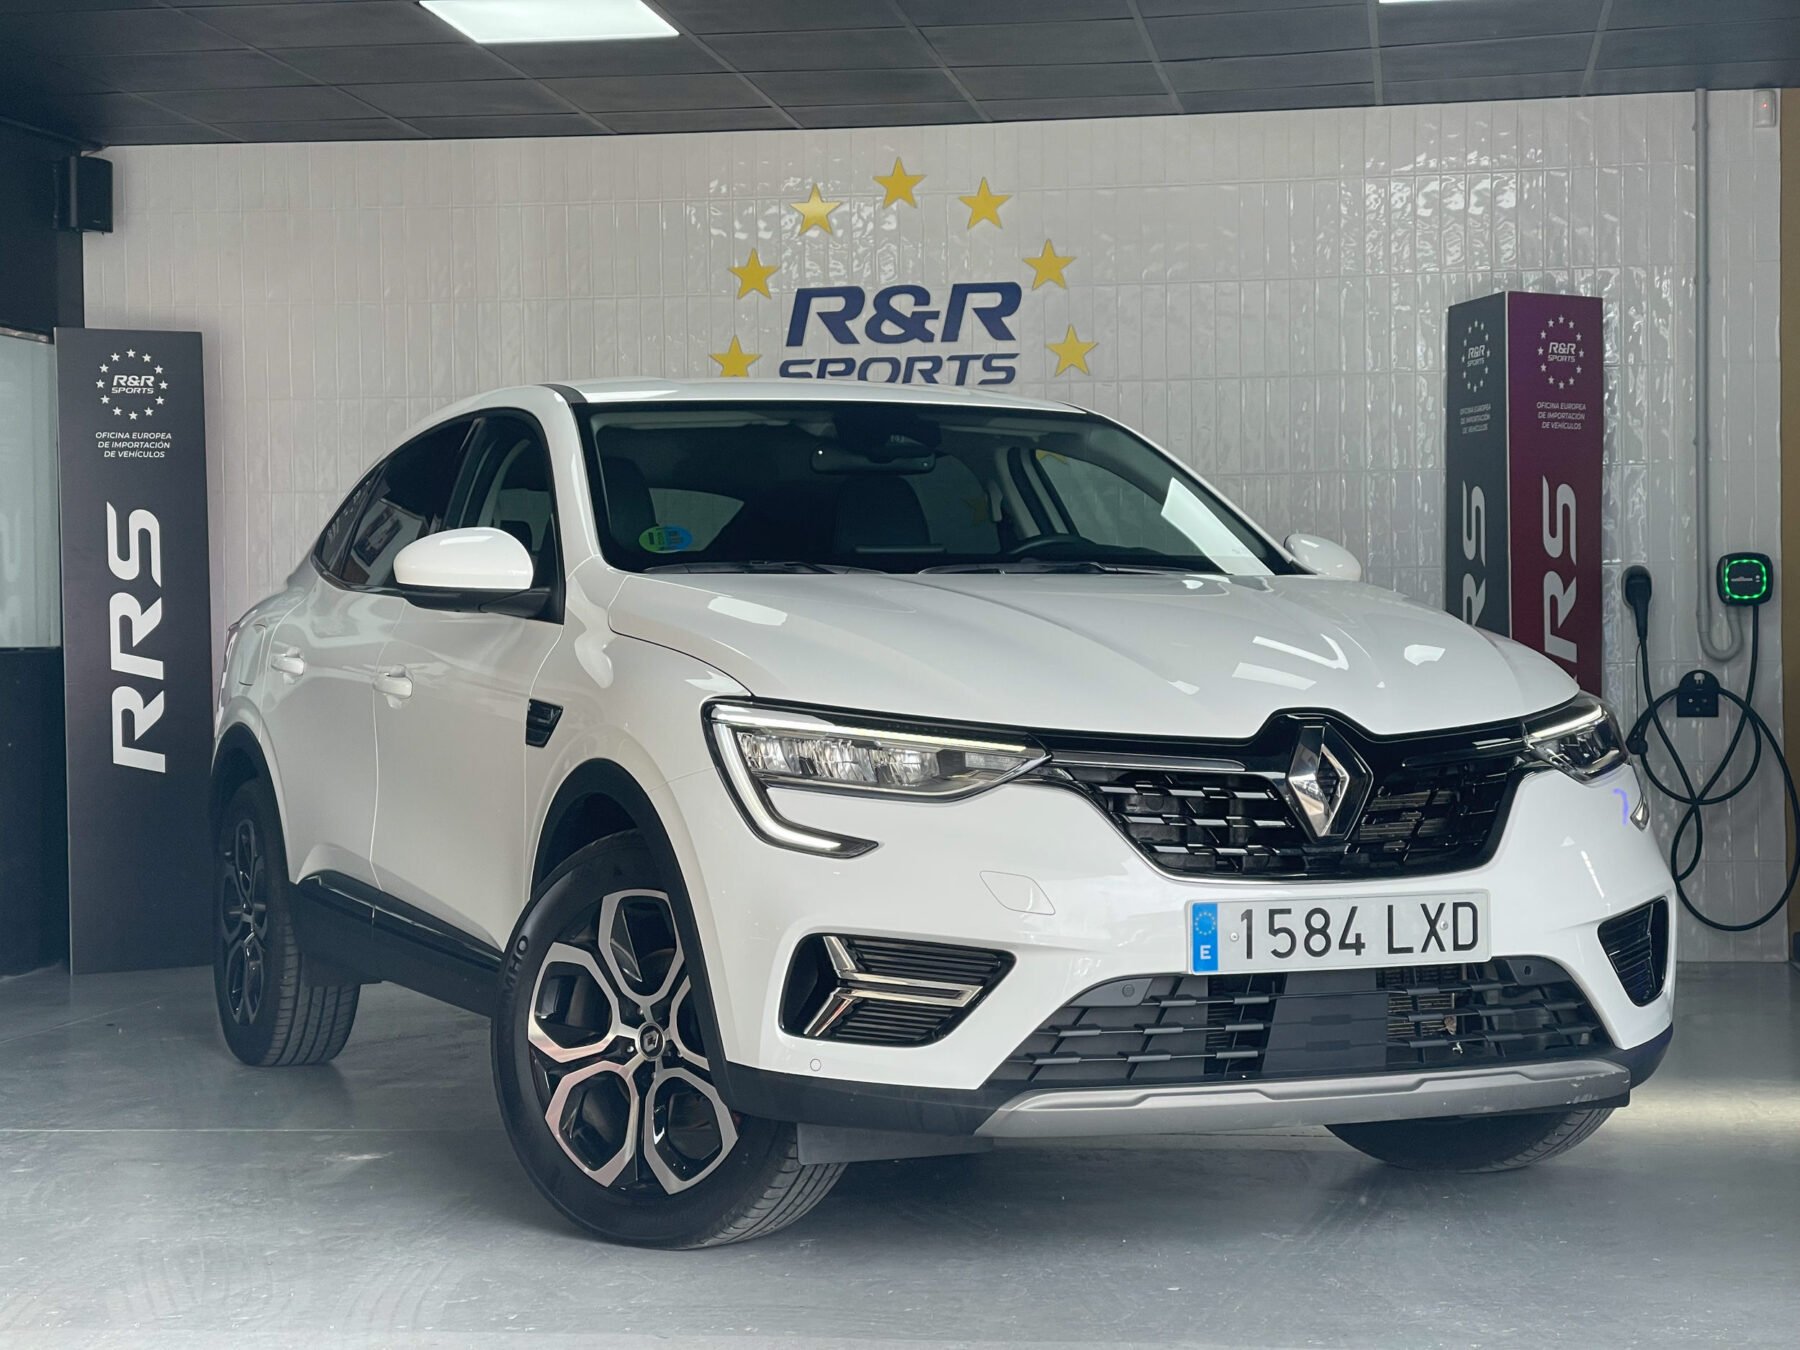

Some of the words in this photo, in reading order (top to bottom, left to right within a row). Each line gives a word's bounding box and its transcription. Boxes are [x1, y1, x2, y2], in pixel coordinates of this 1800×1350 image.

[786, 281, 1022, 347] R&R
[1468, 345, 1485, 359] R&R
[1549, 342, 1576, 354] R&R
[1547, 354, 1576, 363] SPORTS
[779, 353, 1021, 386] SPORTS
[112, 375, 154, 387] R&R
[1541, 421, 1550, 429] DE
[112, 441, 170, 449] IMPORTACIÓN
[118, 450, 165, 458] VEHÍCULOS
[1462, 480, 1486, 627] RS
[1542, 474, 1577, 682] RS
[106, 501, 166, 773] RRS
[1240, 906, 1366, 960] 1584
[1387, 901, 1479, 955] LXD
[1200, 945, 1212, 960] E
